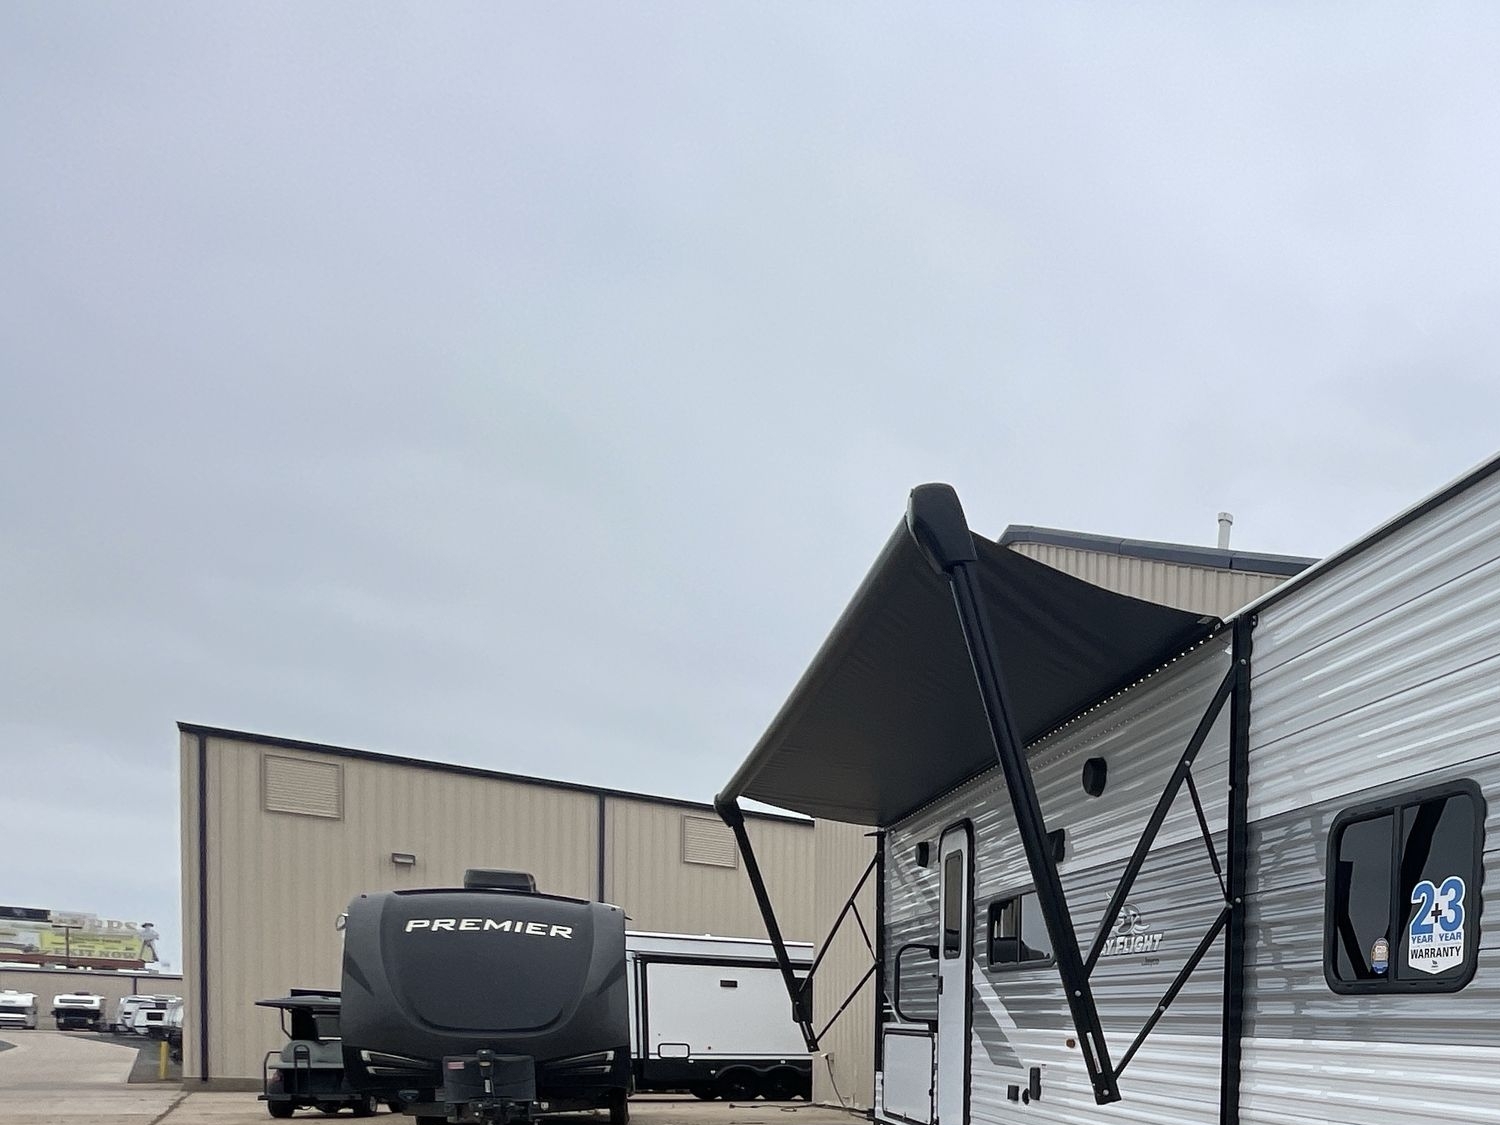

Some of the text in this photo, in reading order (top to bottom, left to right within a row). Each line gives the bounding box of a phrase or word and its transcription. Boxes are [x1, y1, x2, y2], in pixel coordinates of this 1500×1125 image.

[405, 918, 573, 939] PREMIER
[1116, 933, 1163, 954] FLIGHT
[1411, 932, 1462, 945] YEAR YEAR
[1411, 946, 1461, 959] WARRANTY
